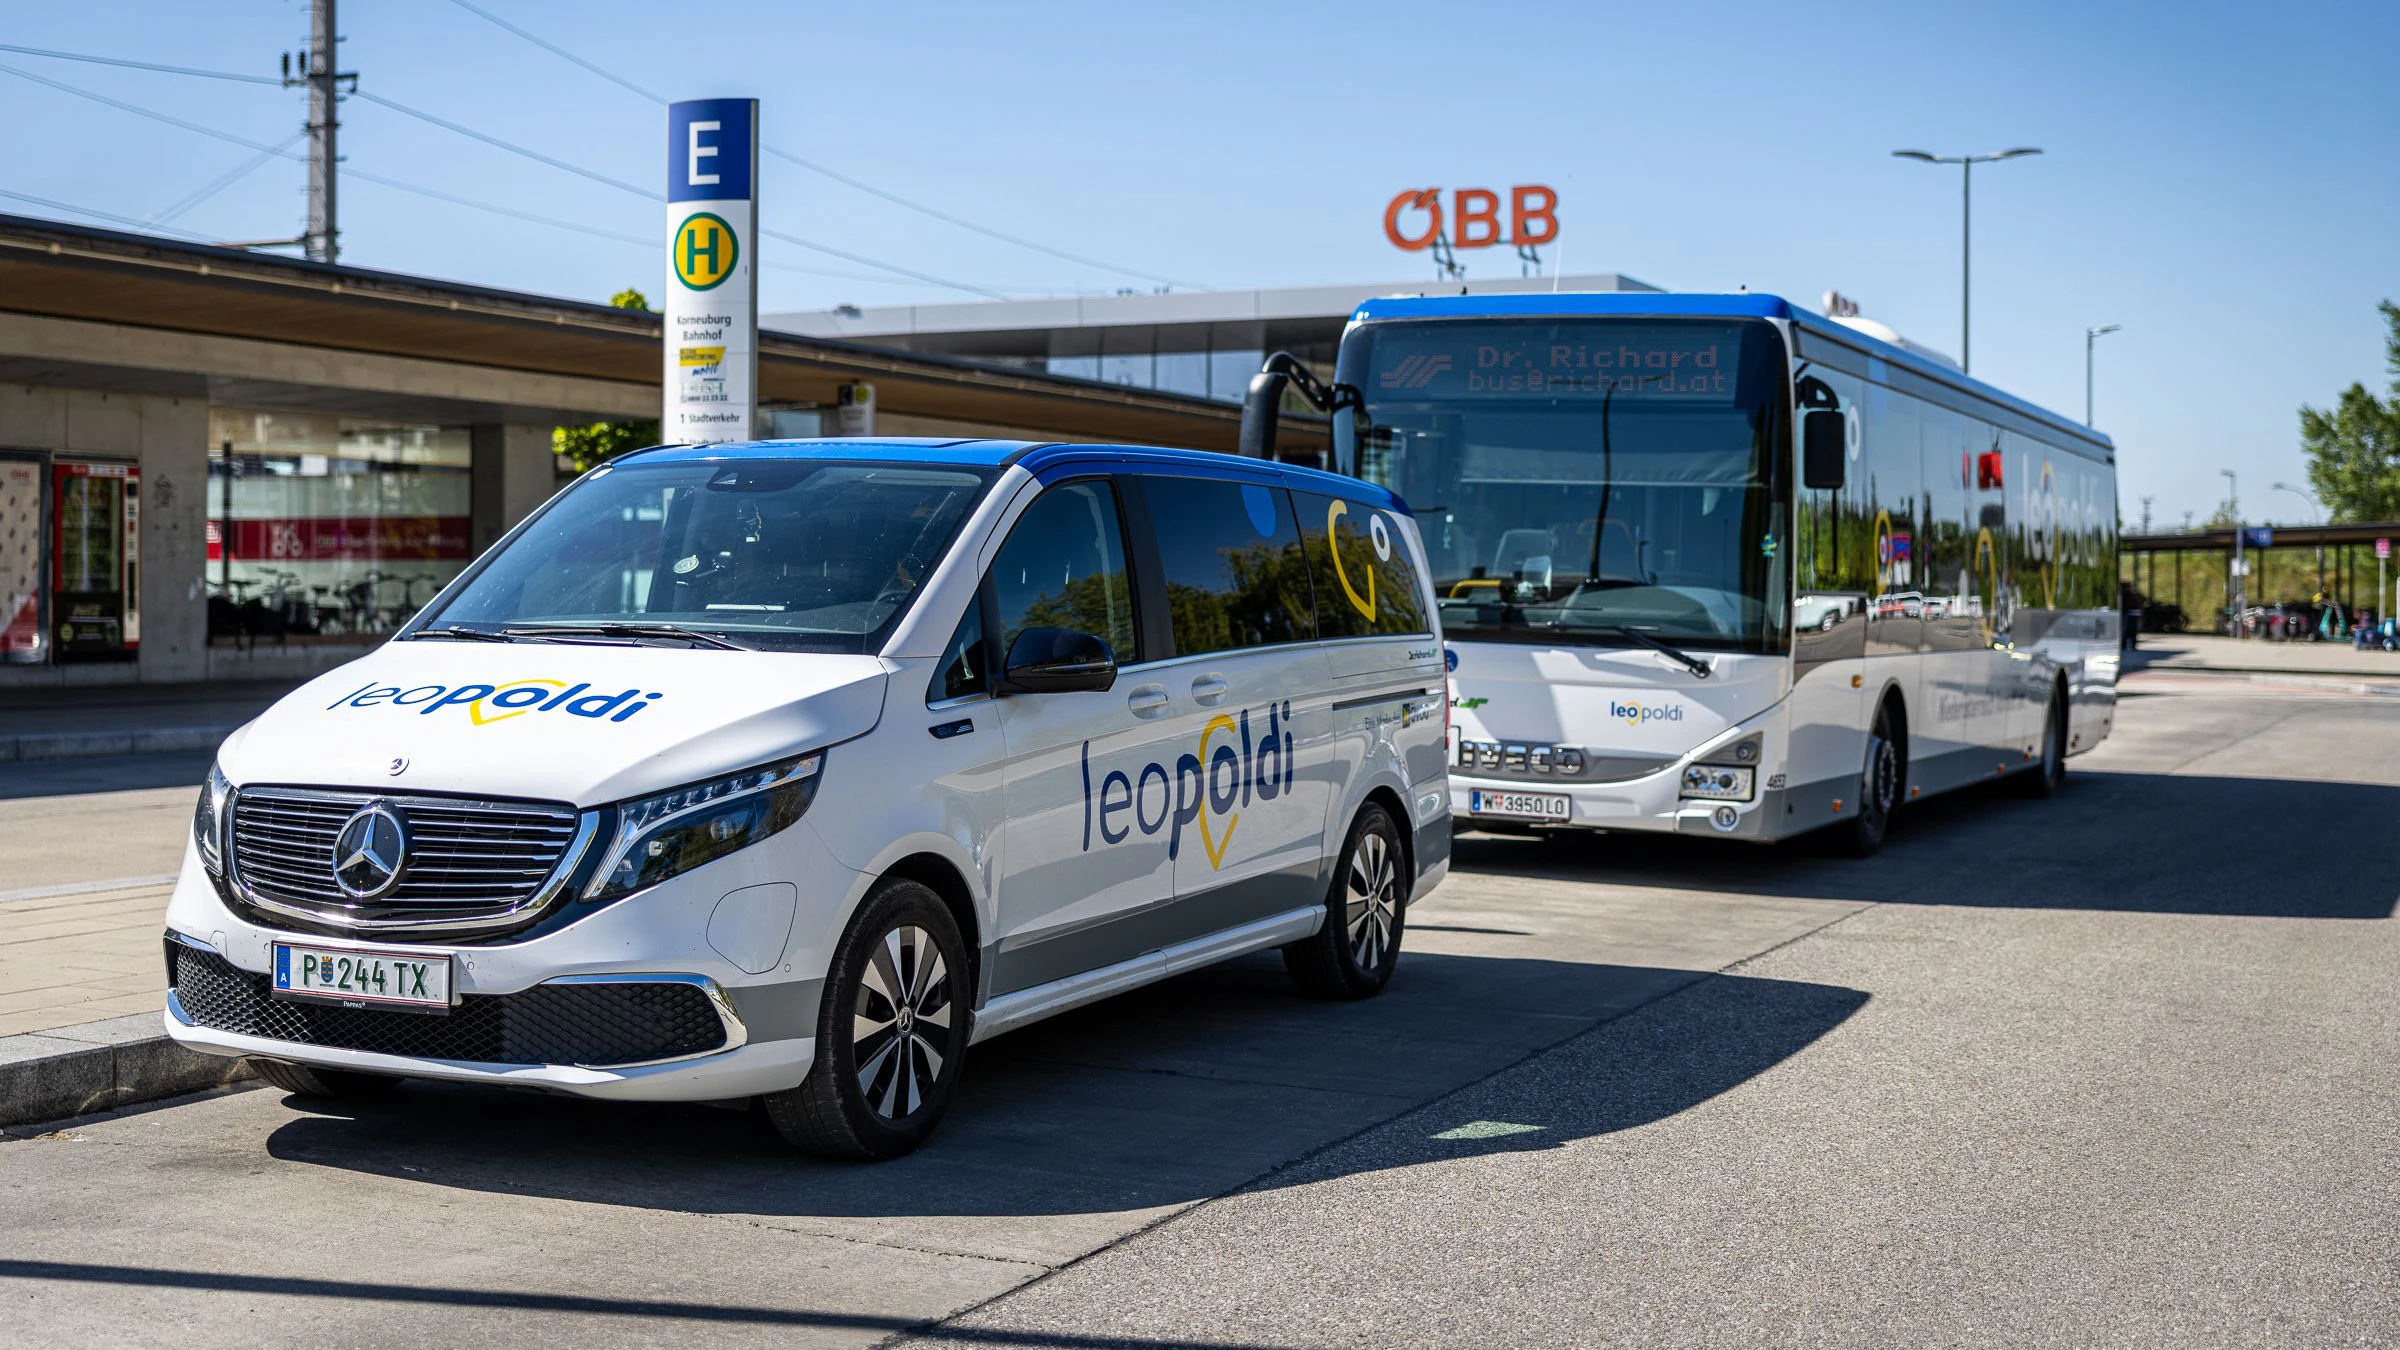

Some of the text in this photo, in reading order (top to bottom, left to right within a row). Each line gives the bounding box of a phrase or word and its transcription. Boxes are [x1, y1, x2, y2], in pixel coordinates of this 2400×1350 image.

[688, 121, 721, 185] E
[1384, 185, 1559, 253] ÖBB
[687, 228, 719, 275] H
[677, 314, 732, 328] Korneuburg
[683, 329, 723, 341] Bahnhof
[1477, 344, 1719, 369] Dr. Richard
[1468, 369, 1726, 393] bus@richard.at
[689, 413, 740, 424] Stadtverkehr
[327, 682, 663, 725] leopoldi
[1610, 701, 1683, 723] leopoldi
[1462, 740, 1584, 774] IVECO
[1082, 700, 1294, 862] leopoldi
[1482, 794, 1493, 809] W
[280, 954, 426, 996] A P 244 TX
